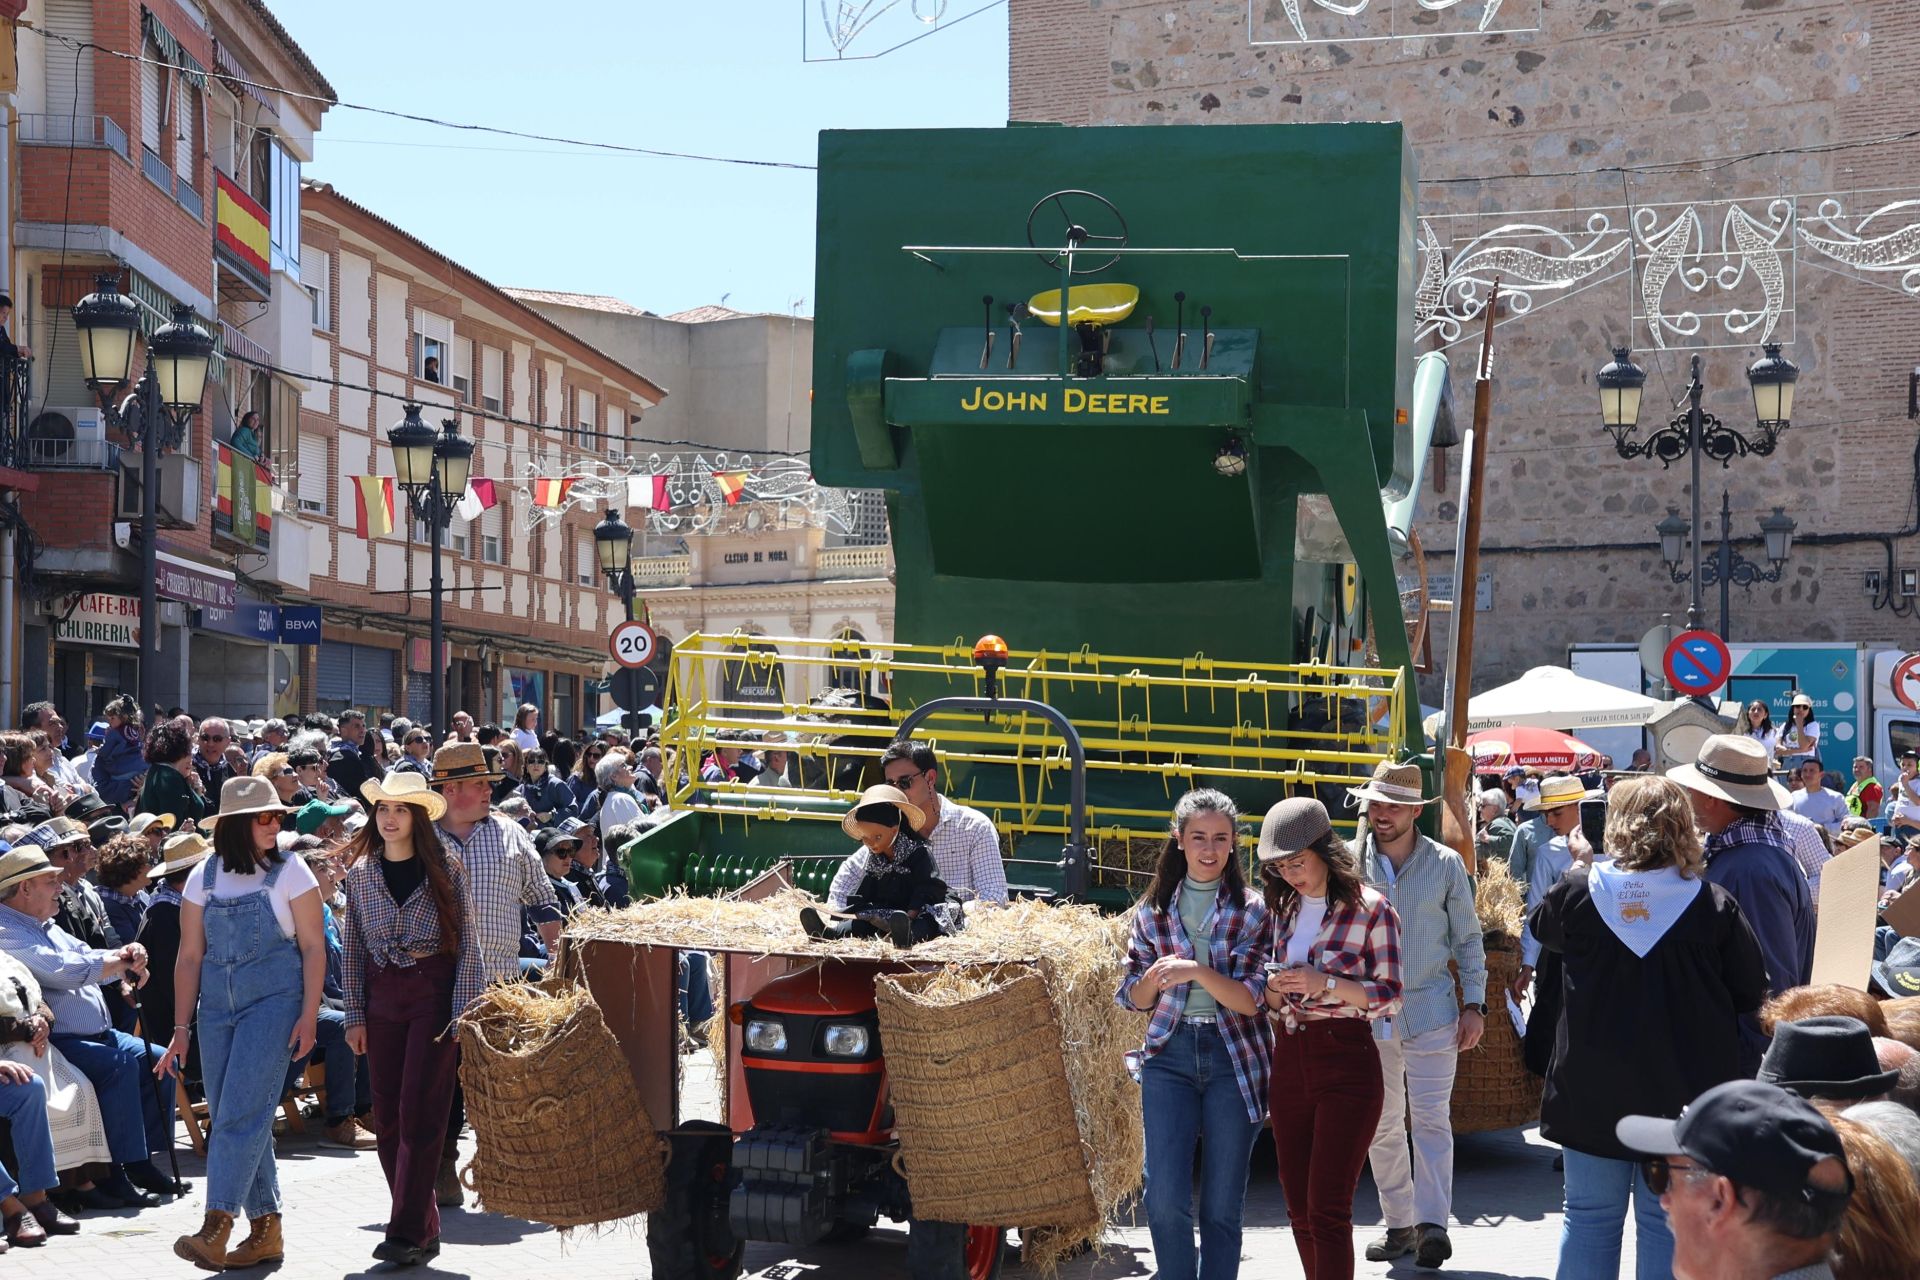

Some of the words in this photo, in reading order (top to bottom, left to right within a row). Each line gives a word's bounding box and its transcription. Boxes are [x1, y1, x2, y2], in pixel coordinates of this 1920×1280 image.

[961, 386, 1047, 411] JOHN
[1064, 388, 1169, 414] DEERE
[724, 551, 749, 564] CASINO
[753, 551, 763, 562] DE
[768, 550, 788, 562] MORA
[258, 609, 274, 632] BBVA
[285, 620, 318, 630] BBVA
[57, 620, 130, 643] CHURRERIA
[620, 635, 647, 654] 20
[1773, 698, 1829, 707] Muzas
[1467, 718, 1502, 729] hambra
[1623, 880, 1644, 889] Peña
[1617, 891, 1629, 899] El
[1629, 889, 1650, 898] Hato
